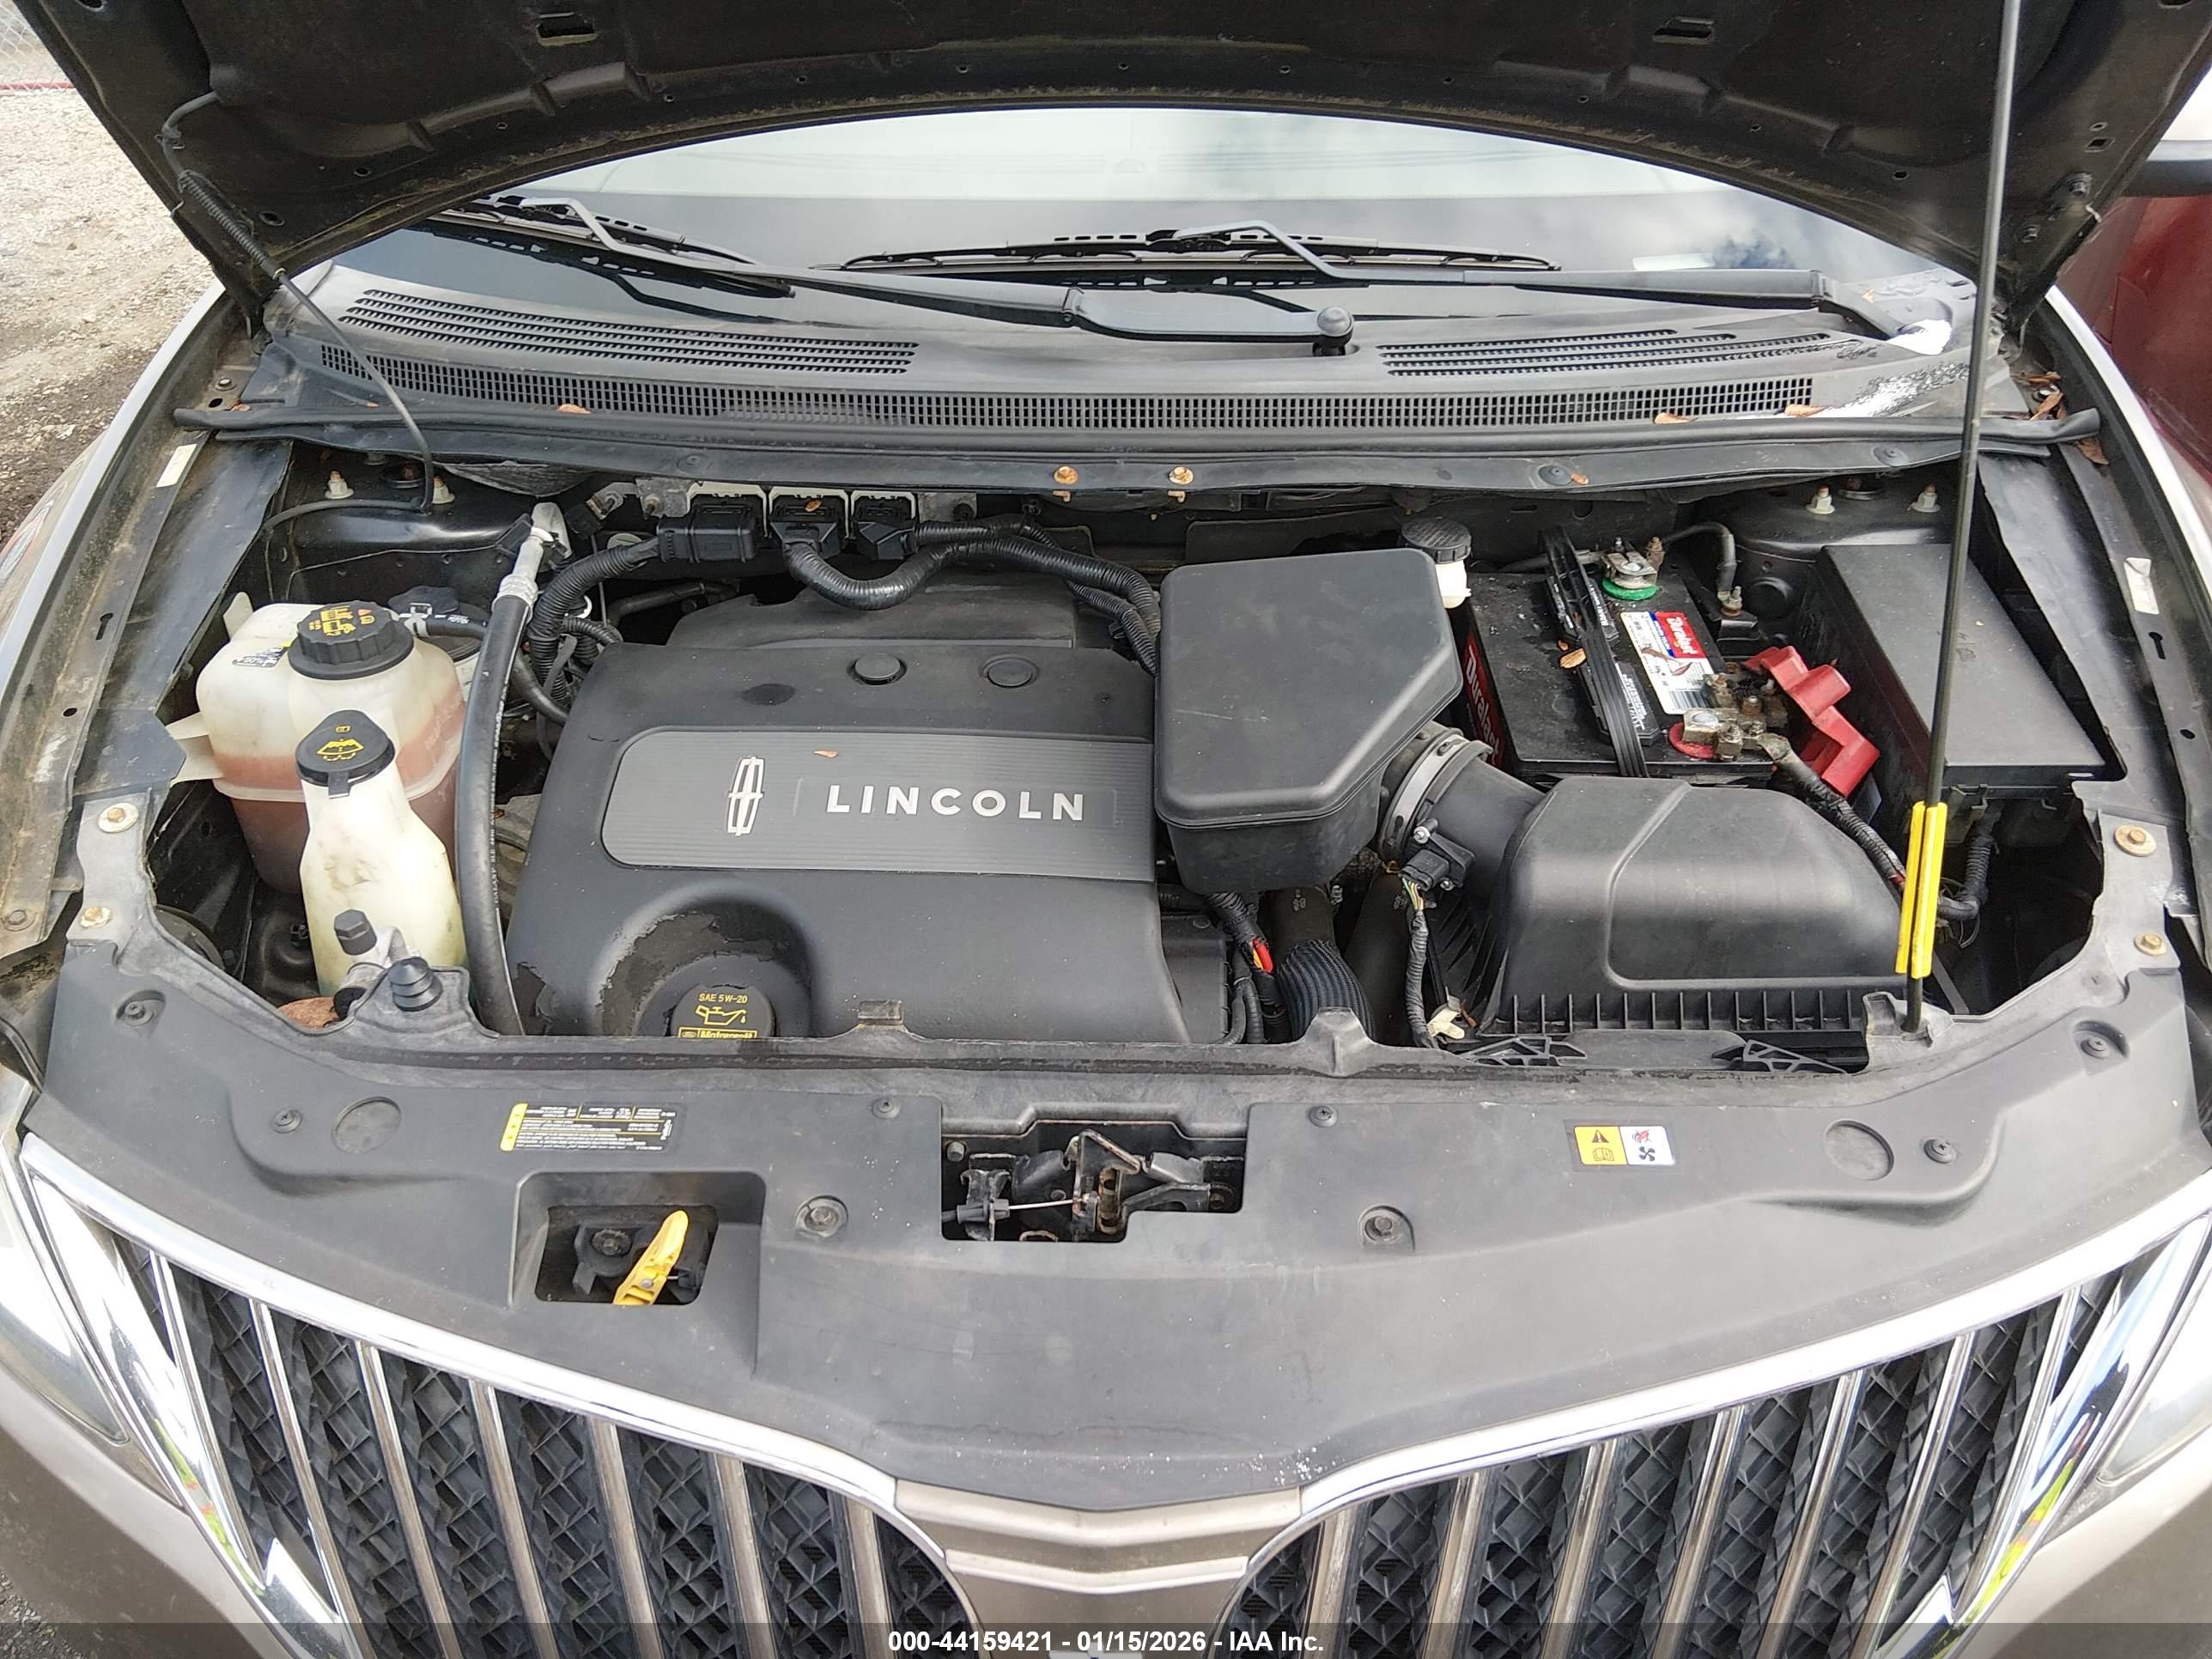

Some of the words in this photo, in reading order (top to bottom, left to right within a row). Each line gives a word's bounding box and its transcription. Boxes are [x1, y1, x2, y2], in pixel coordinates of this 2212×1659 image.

[1665, 617, 1698, 654] Duralast
[826, 785, 1085, 821] LINCOLN
[698, 993, 717, 1002] SAE
[717, 994, 749, 1004] 5W-20
